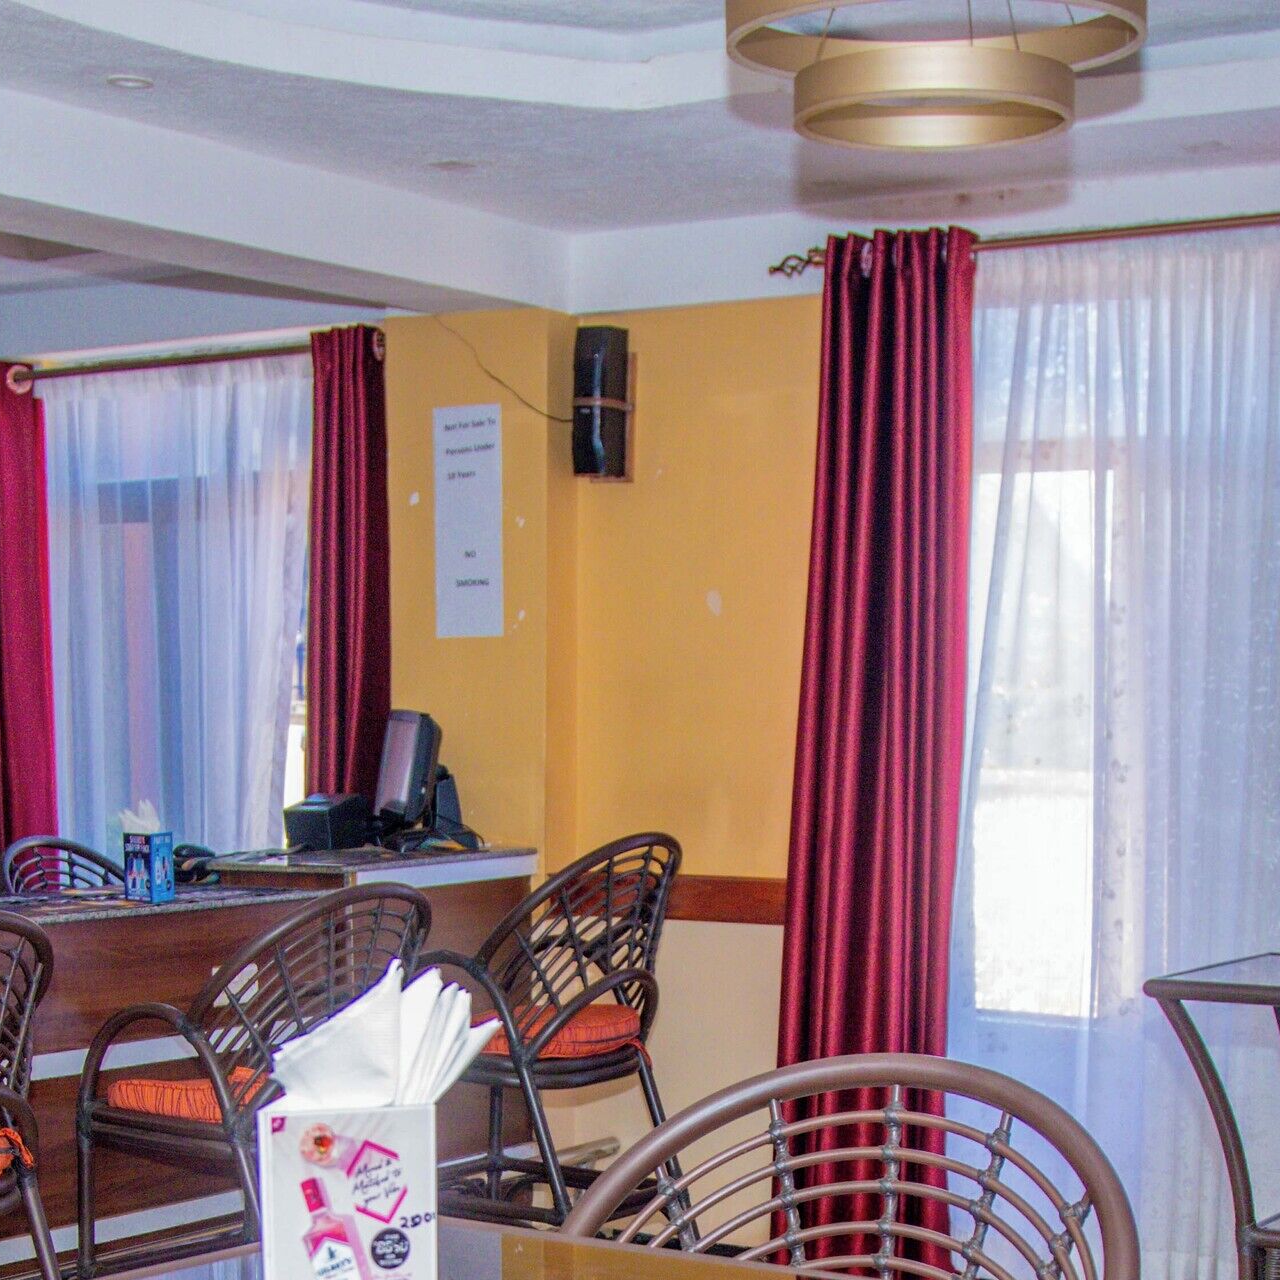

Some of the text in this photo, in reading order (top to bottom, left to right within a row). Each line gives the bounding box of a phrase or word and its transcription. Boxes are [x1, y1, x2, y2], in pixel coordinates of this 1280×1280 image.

[444, 417, 497, 432] Not For Sale To
[445, 441, 496, 456] Persons Under
[457, 469, 477, 481] Years
[464, 550, 477, 559] NO
[456, 577, 490, 588] SMOKING
